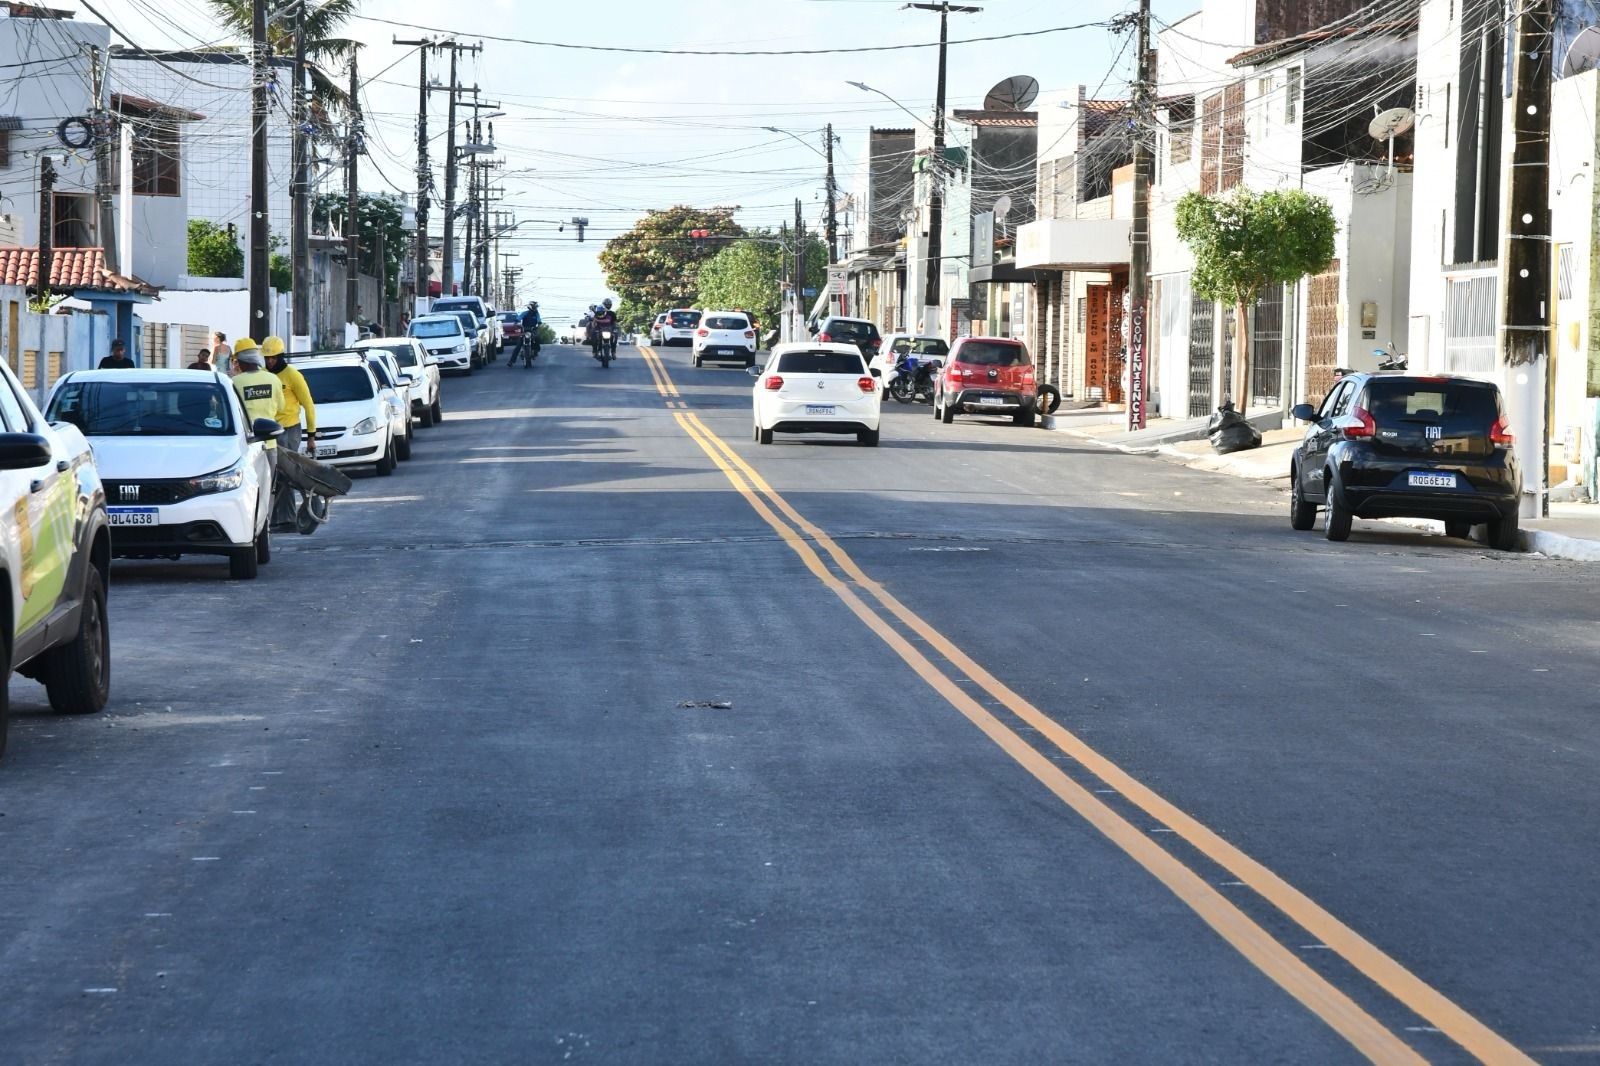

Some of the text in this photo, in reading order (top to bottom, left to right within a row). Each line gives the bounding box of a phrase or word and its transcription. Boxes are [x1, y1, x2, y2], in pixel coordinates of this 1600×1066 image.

[1425, 426, 1442, 439] FIAT
[1412, 475, 1451, 486] RQG6E12
[119, 485, 141, 500] FIAT
